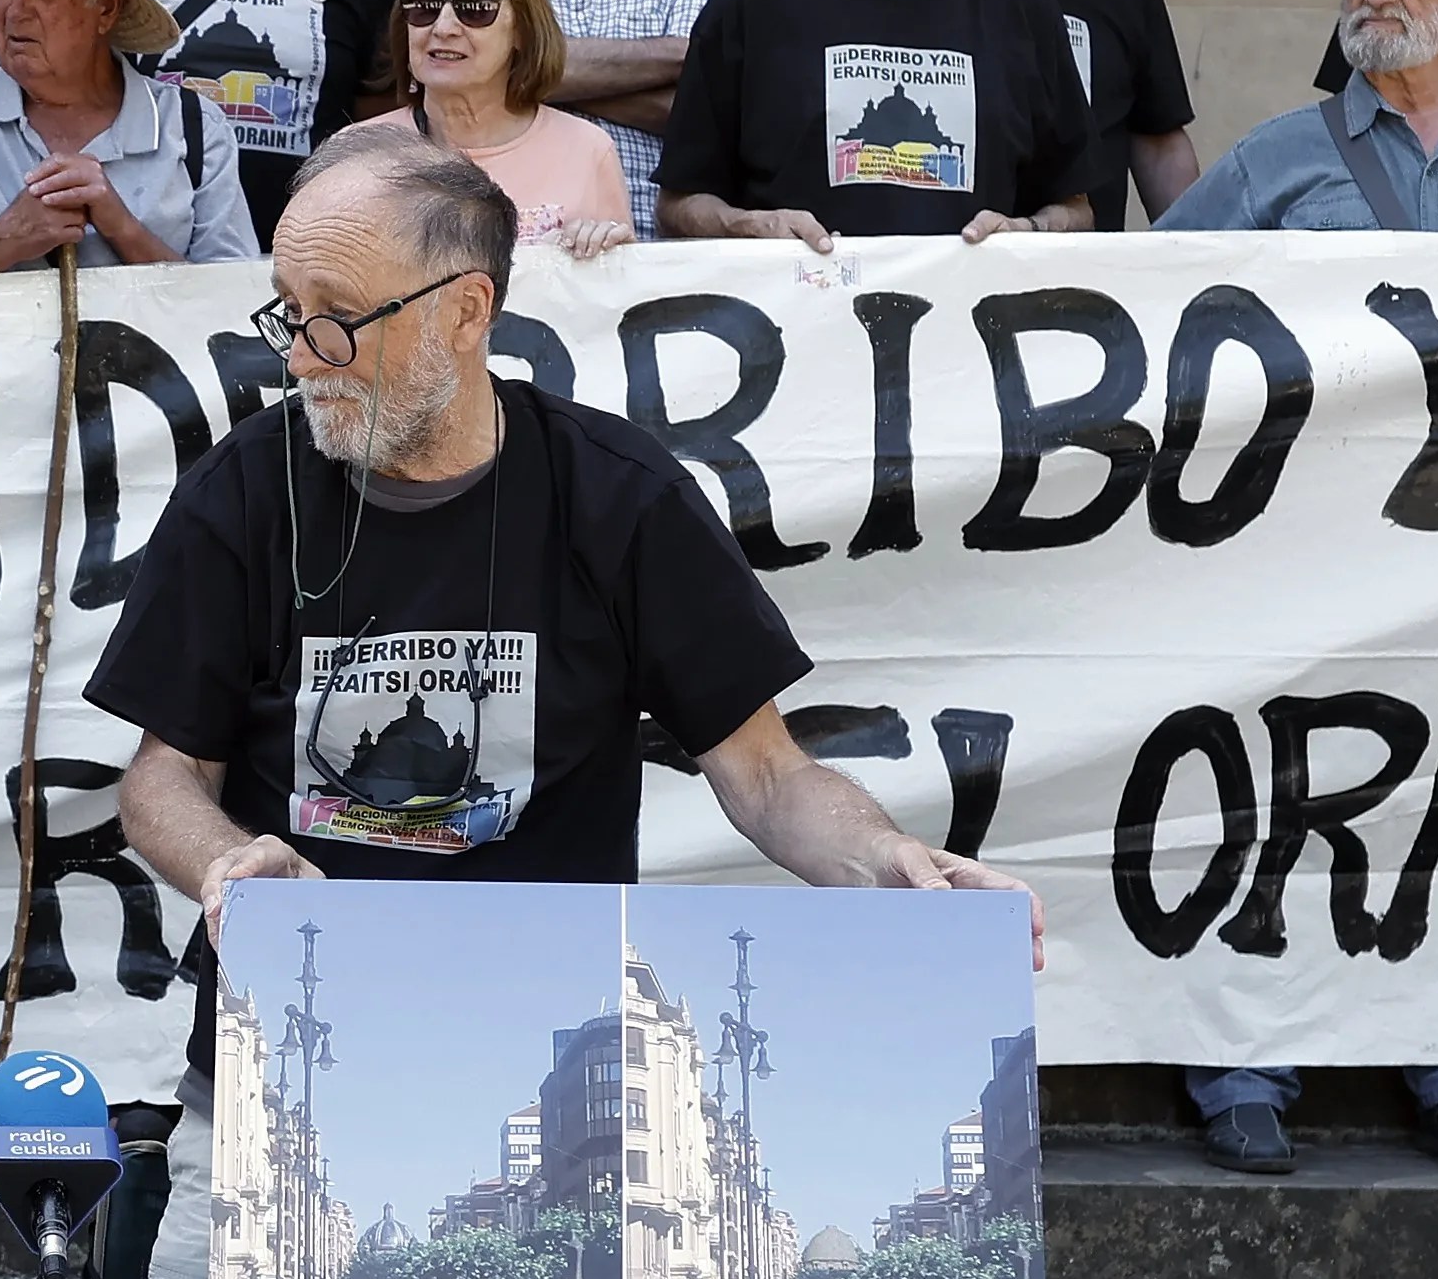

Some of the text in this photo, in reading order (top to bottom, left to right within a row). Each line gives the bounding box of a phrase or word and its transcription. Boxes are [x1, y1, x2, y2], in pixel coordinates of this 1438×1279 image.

[833, 48, 966, 69] ¡¡¡DERRIBO YA!!!
[306, 74, 317, 92] por
[833, 66, 966, 86] ERAITSI ORAIN!!!
[465, 638, 524, 661] YA!!!
[310, 669, 522, 694] ERAITSI ORAN!!!
[9, 1129, 66, 1142] radio
[10, 1142, 92, 1156] euskadi
